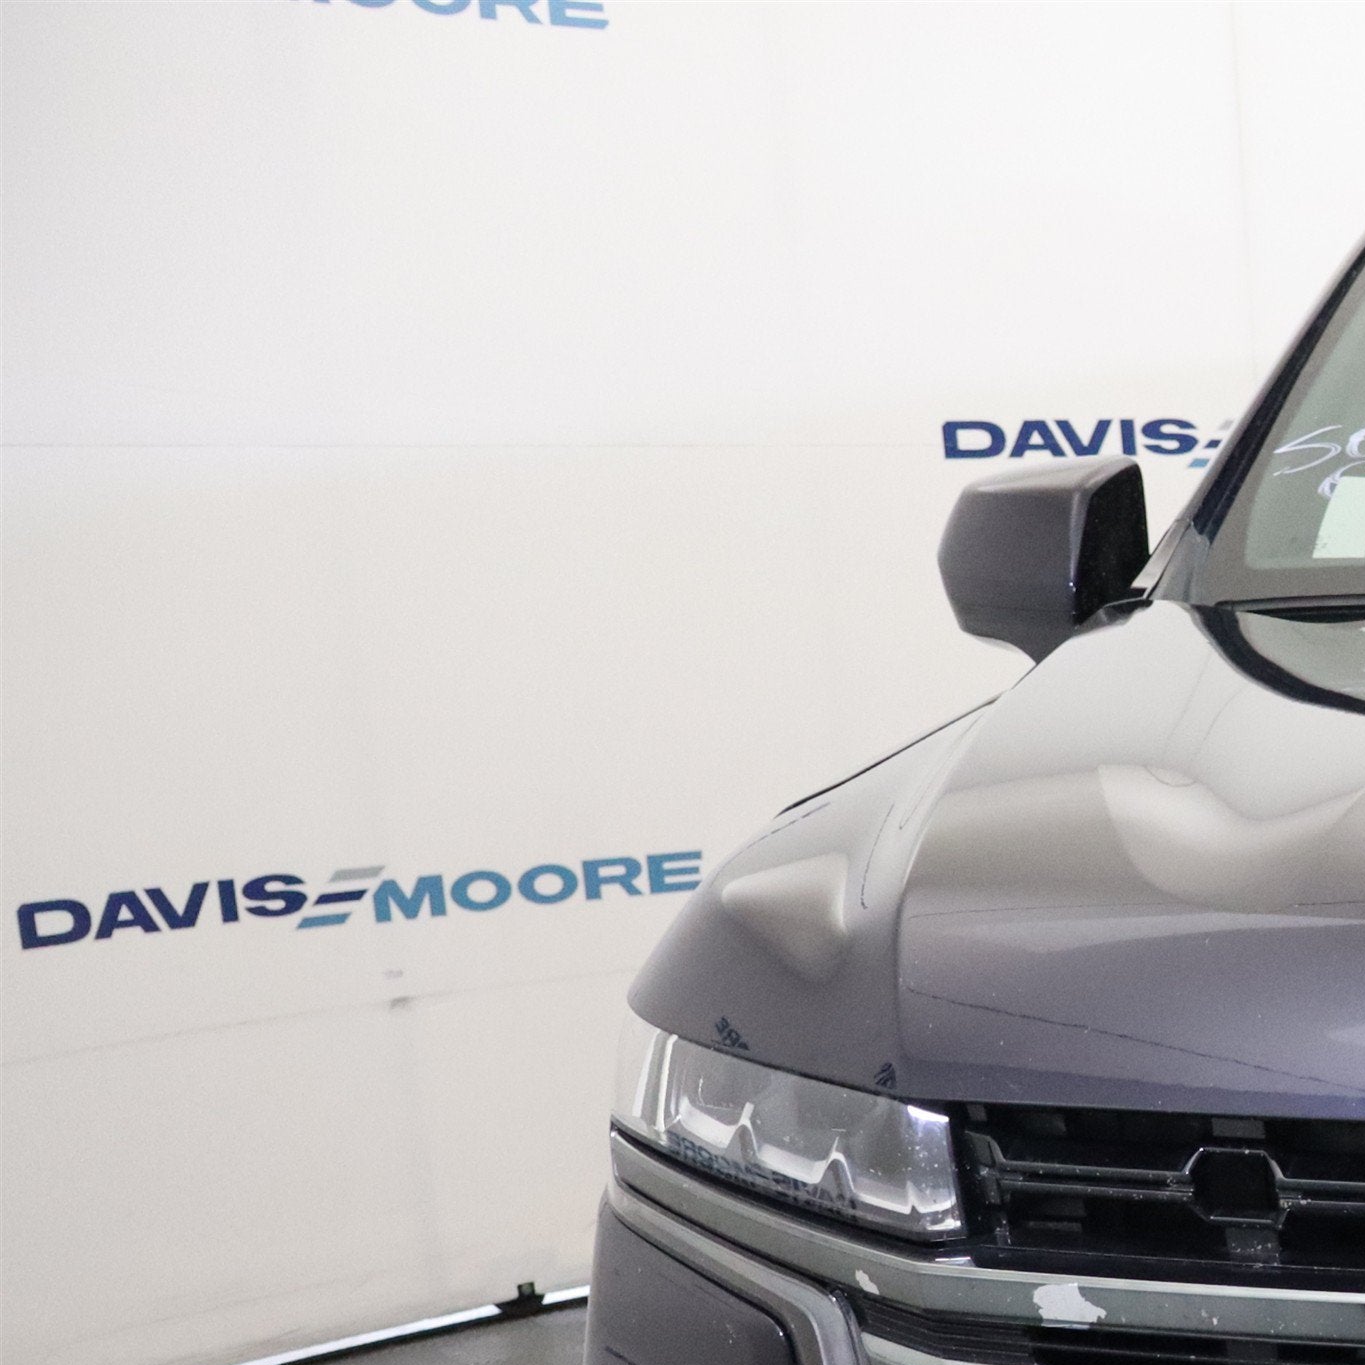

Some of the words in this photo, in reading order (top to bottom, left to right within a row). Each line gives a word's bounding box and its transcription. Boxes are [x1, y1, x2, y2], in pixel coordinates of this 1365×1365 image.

[942, 418, 1200, 460] DAVIS
[16, 873, 308, 950] DAVIS
[373, 850, 704, 924] MOORE
